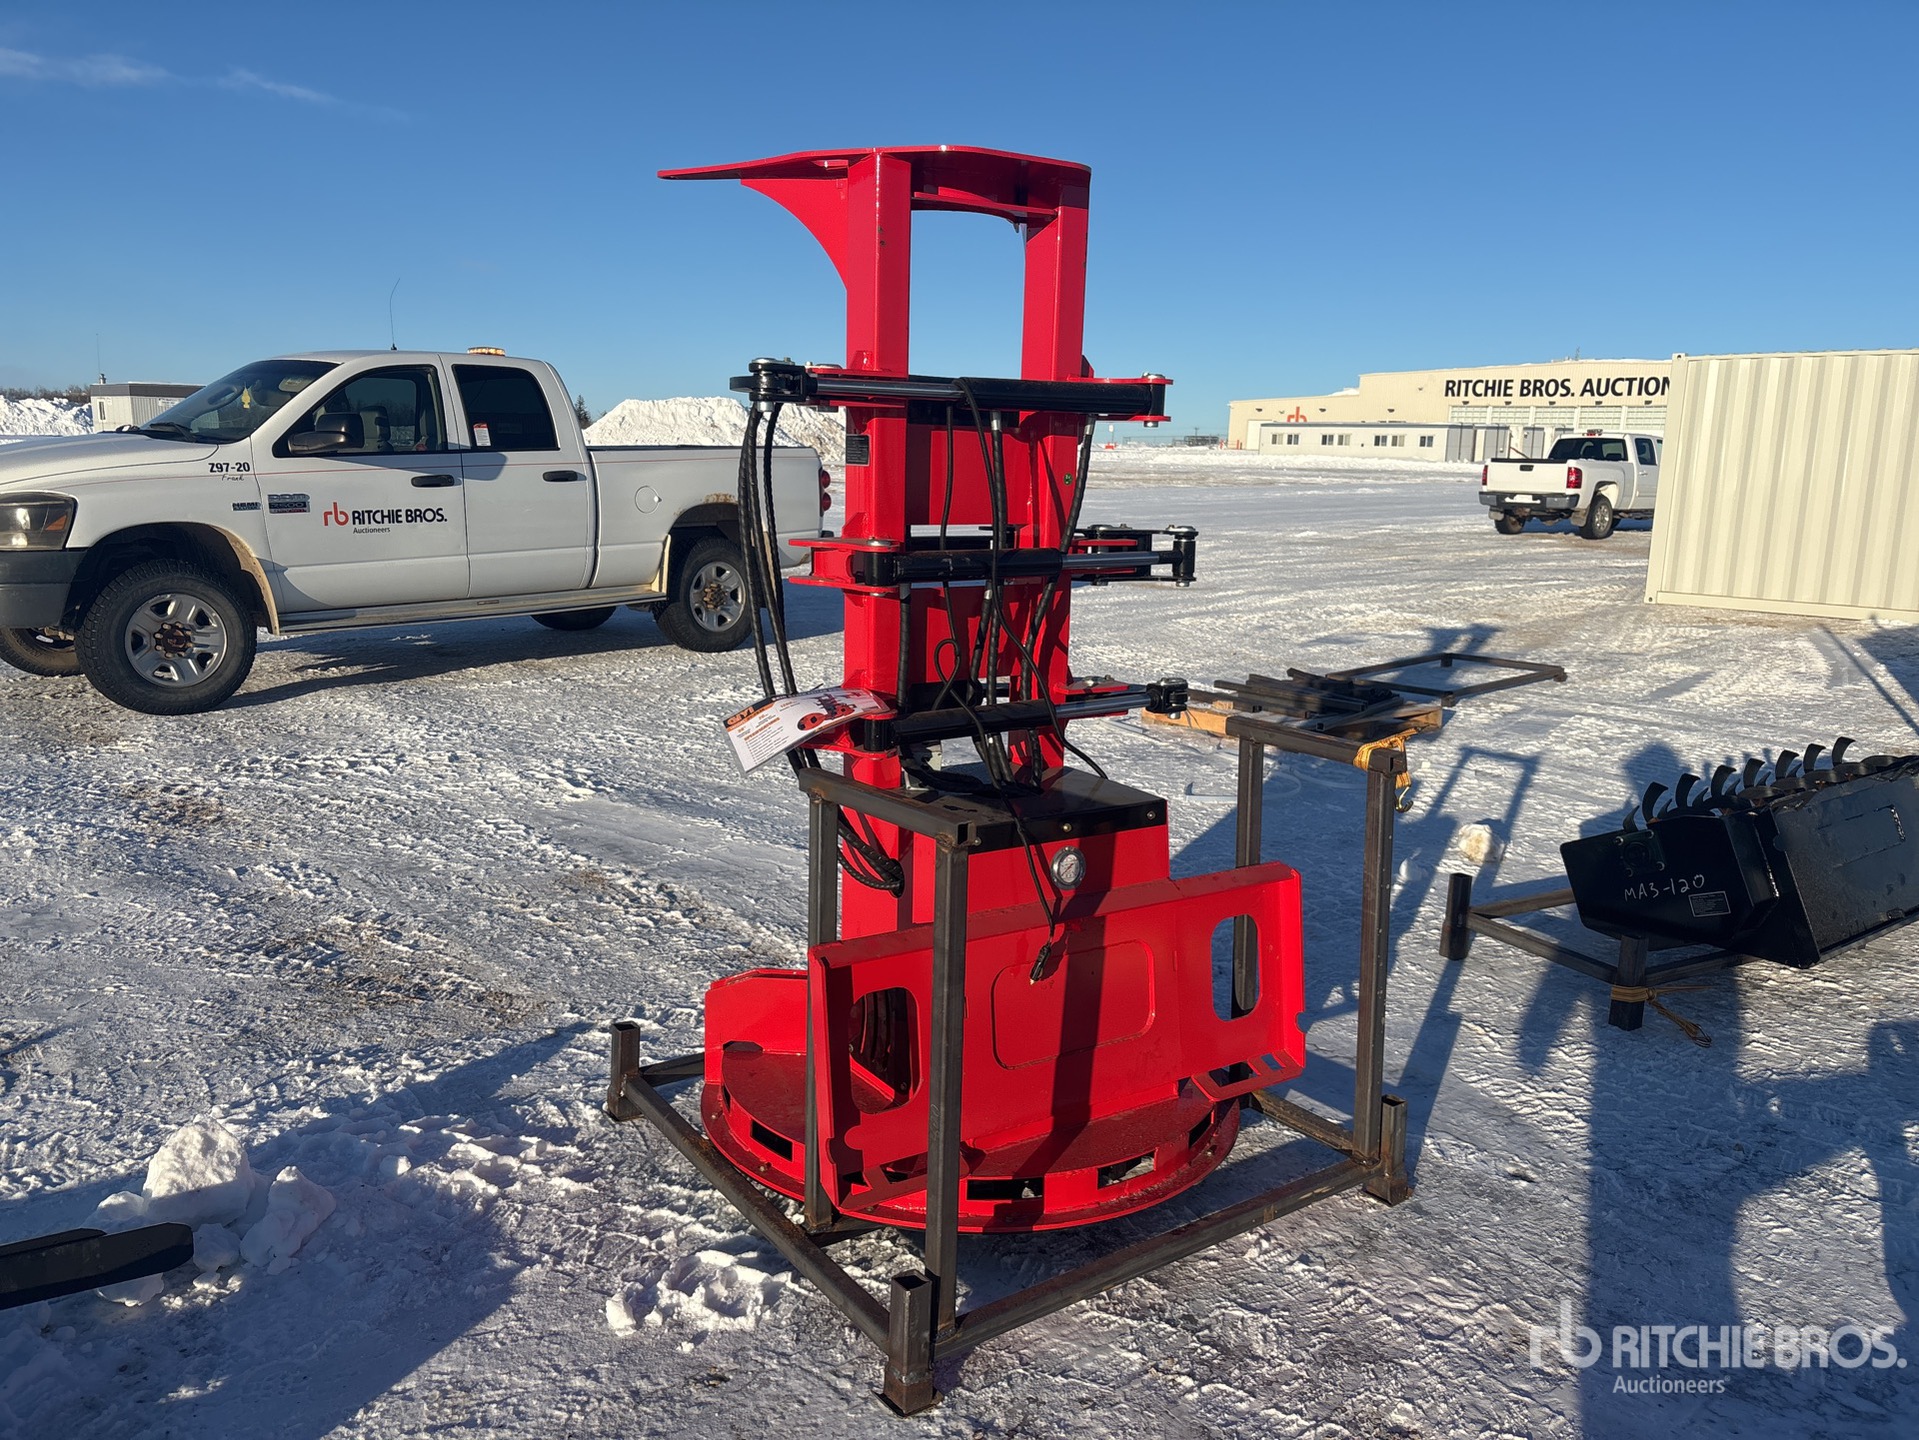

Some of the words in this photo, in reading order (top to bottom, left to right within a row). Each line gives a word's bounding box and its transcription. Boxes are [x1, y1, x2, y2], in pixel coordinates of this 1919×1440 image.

[1444, 379, 1514, 397] RITCHIE
[1519, 378, 1575, 397] BROS.
[208, 462, 250, 473] Z97-20
[323, 502, 349, 526] rb
[351, 509, 403, 525] RITCHIE
[405, 507, 448, 523] BROS.
[353, 526, 391, 534] Auctioneers
[1624, 873, 1705, 901] MA3-120
